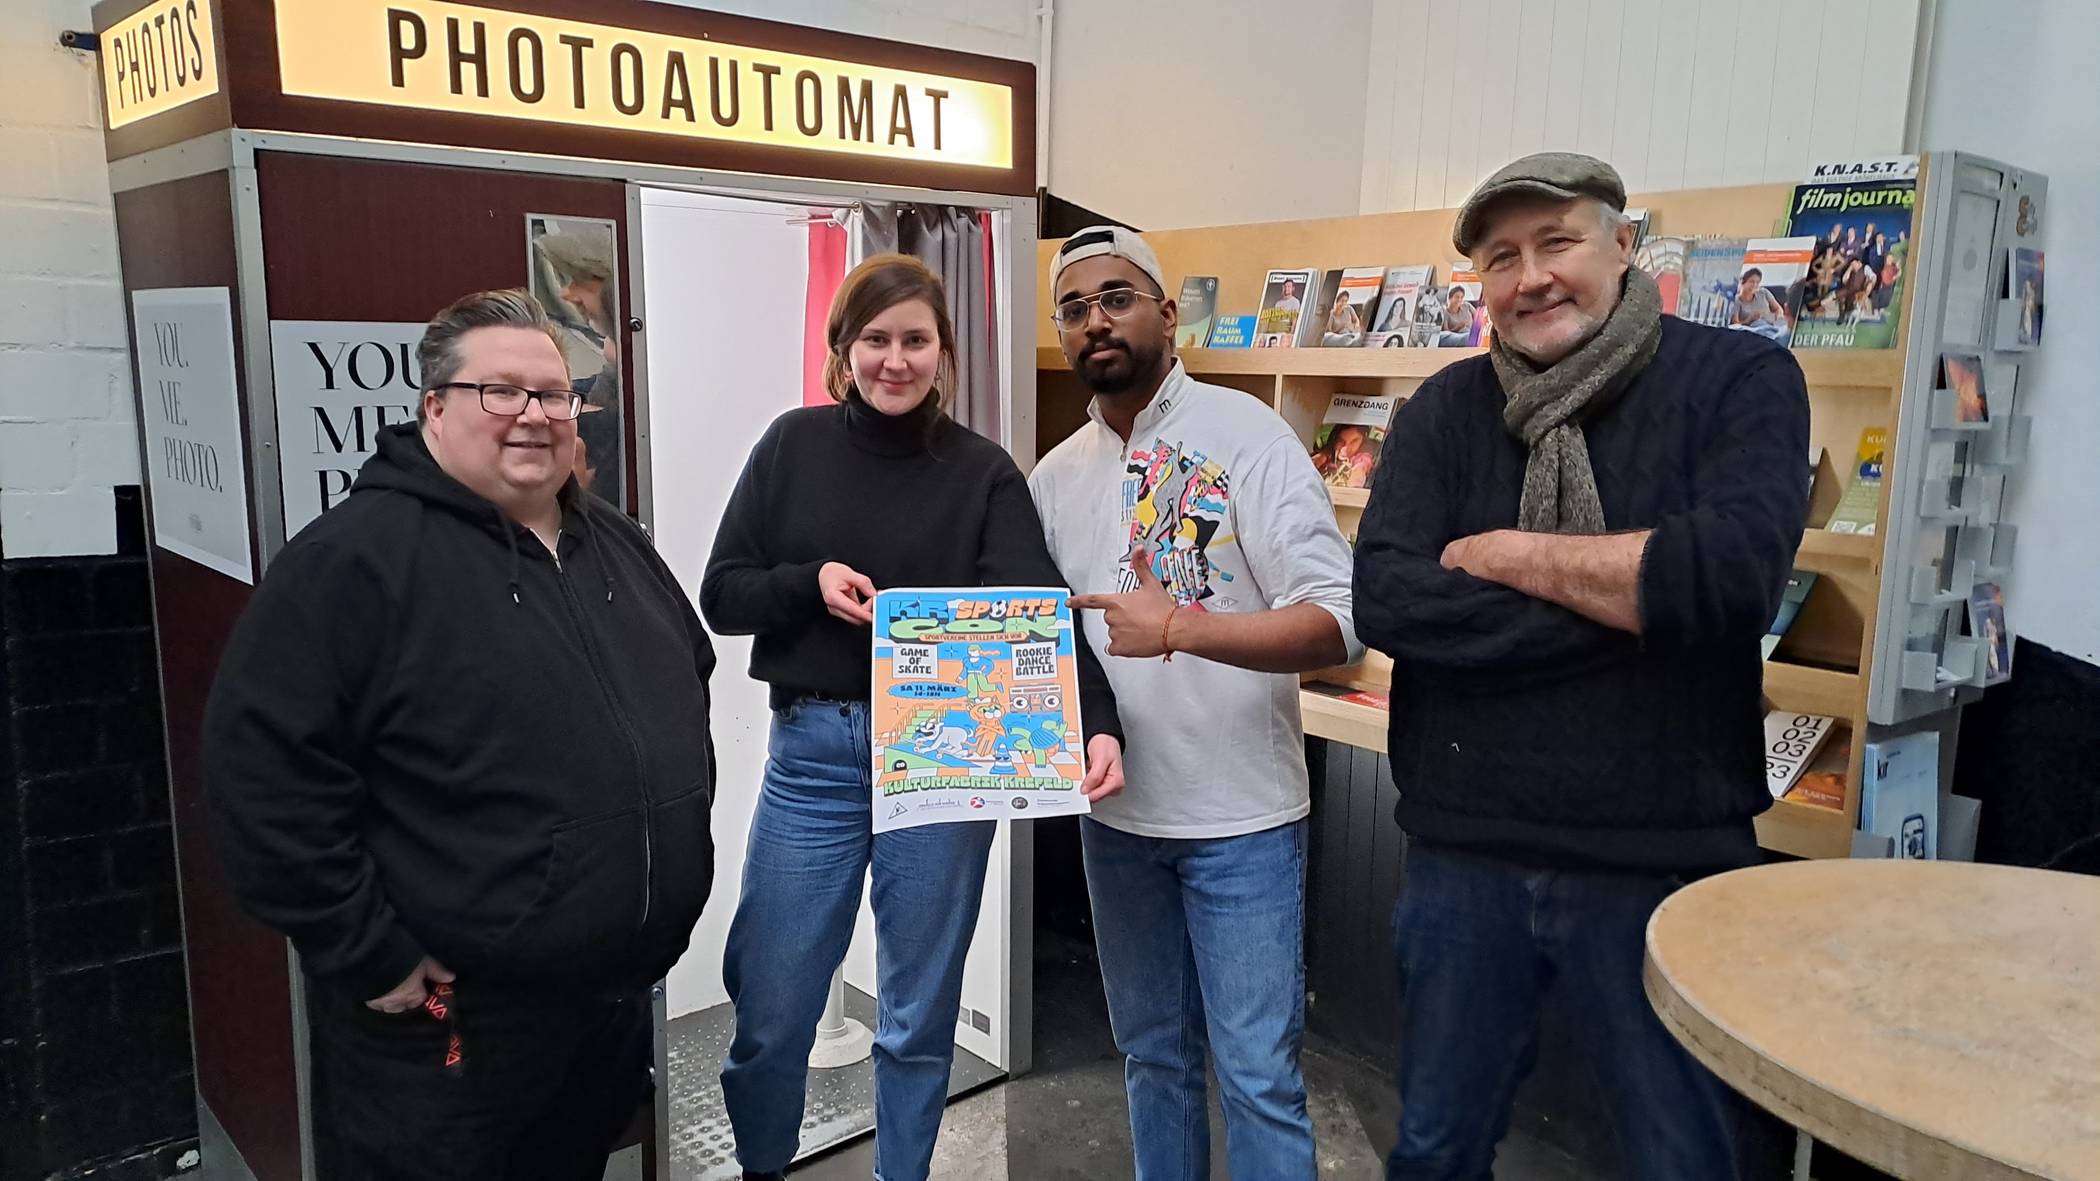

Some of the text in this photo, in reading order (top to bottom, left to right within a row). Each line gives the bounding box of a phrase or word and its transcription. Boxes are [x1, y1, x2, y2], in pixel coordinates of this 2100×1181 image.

[113, 0, 203, 109] PHOTOS
[387, 7, 949, 151] PHOTOAUTOMAT
[1814, 162, 1898, 177] K.N.A.S.T.
[1796, 187, 1916, 215] filmjourna
[1220, 317, 1240, 325] FREI
[154, 322, 189, 368] YOU.
[1795, 333, 1855, 346] DER PFAU
[164, 435, 223, 493] PHOTO.
[955, 599, 1057, 620] SPORTS
[889, 616, 1060, 645] CON
[900, 647, 929, 657] GAME
[1015, 646, 1053, 657] ROOKIE
[898, 664, 932, 674] SKATE
[909, 657, 922, 665] OF
[1018, 656, 1051, 666] DANCE
[1015, 664, 1055, 676] BATTLE
[1792, 715, 1824, 731] 01
[1782, 728, 1817, 744] 02
[1772, 741, 1807, 757] 03
[883, 776, 1074, 797] KULTURFABRIK KREFELD
